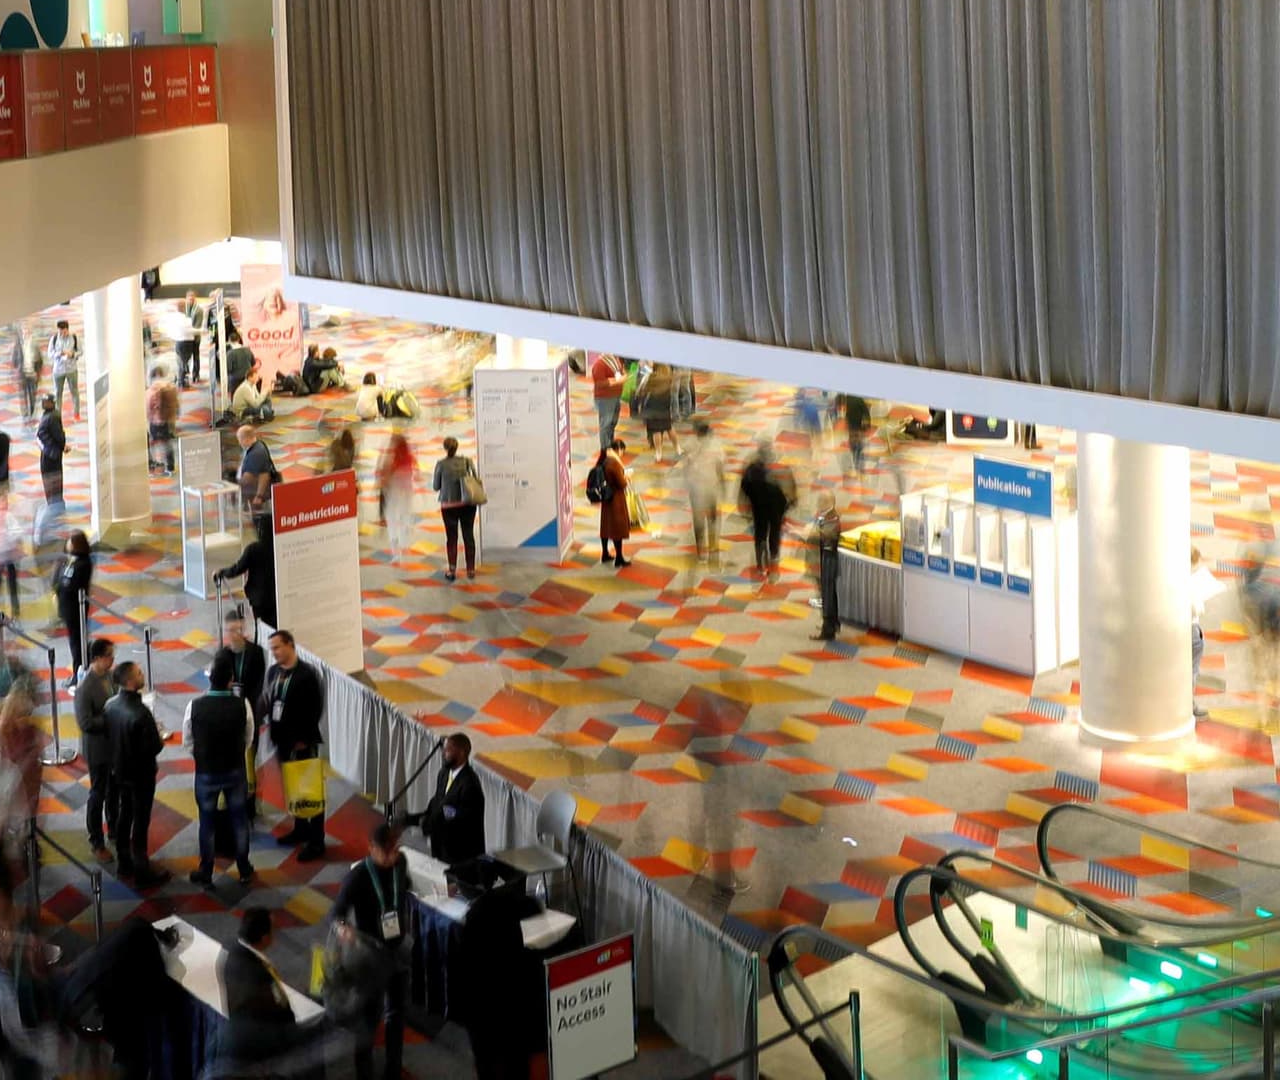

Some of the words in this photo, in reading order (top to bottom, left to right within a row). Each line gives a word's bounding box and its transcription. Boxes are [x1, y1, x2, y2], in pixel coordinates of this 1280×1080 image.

[248, 325, 294, 341] Good
[977, 474, 1032, 498] Publications
[281, 514, 297, 528] Bag
[298, 503, 349, 523] Restrictions
[557, 994, 577, 1013] No
[580, 979, 612, 1004] Stair
[558, 1003, 606, 1032] Access
